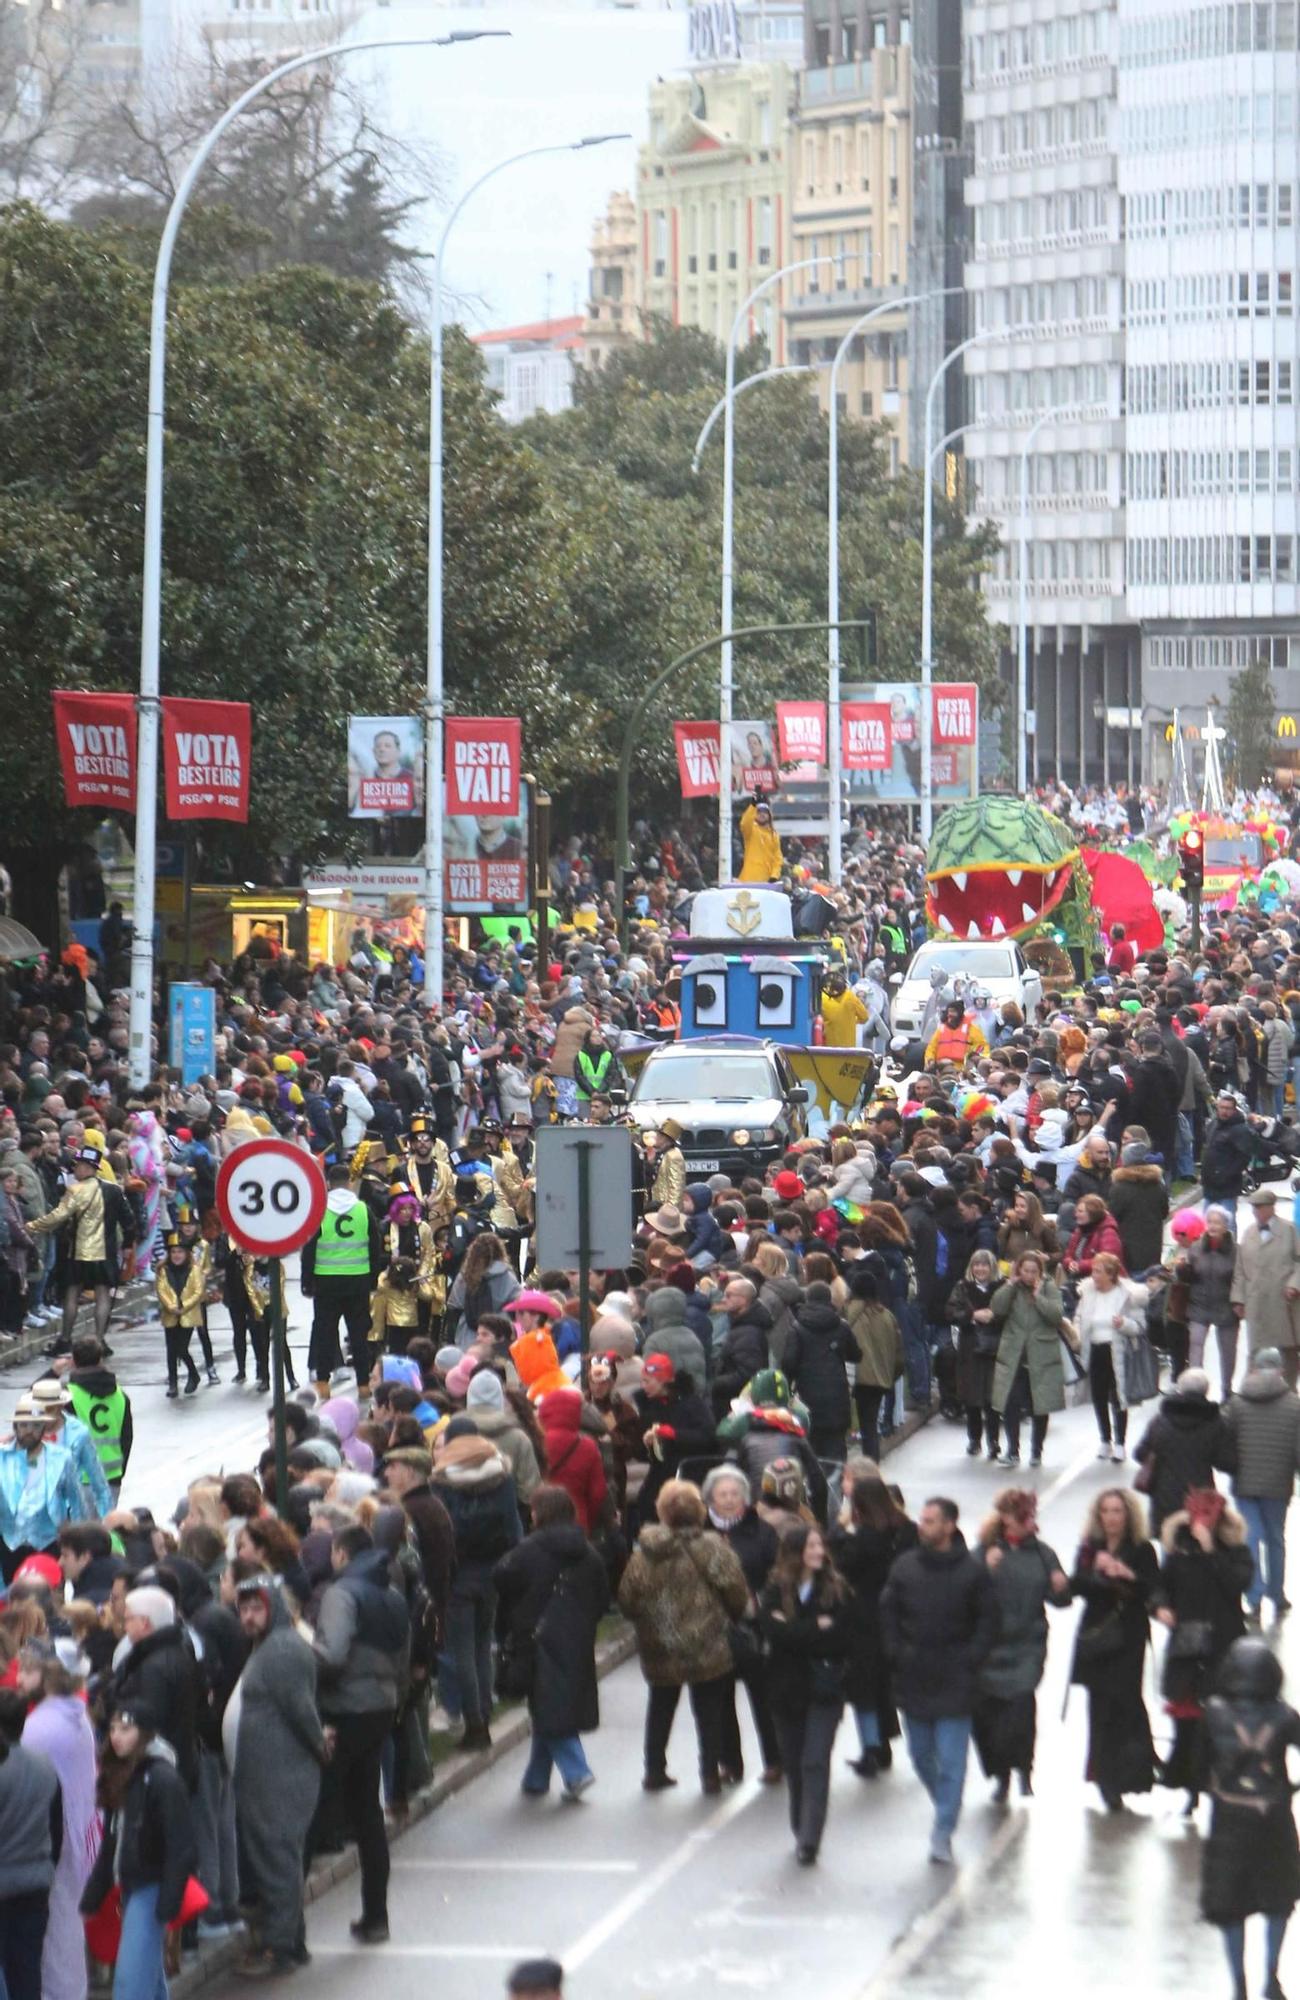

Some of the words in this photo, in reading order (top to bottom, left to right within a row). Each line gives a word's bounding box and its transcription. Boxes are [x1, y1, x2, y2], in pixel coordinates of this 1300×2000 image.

[937, 698, 971, 714] DESTA
[784, 716, 821, 736] VOTA
[848, 720, 885, 740] VOTA
[939, 713, 971, 737] VAI!
[68, 723, 129, 759] VOTA
[175, 732, 241, 768] VOTA
[454, 741, 511, 766] DESTA
[74, 755, 131, 780] BESTEIRO
[178, 766, 241, 788] BESTEIRO
[363, 782, 409, 796] BESTEIRO
[455, 766, 511, 803] VAI!
[449, 863, 481, 877] DESTA
[450, 877, 481, 898] VAI!
[488, 886, 520, 898] PSOE
[238, 1179, 300, 1216] 30
[335, 1214, 354, 1238] C
[89, 1403, 110, 1434] C
